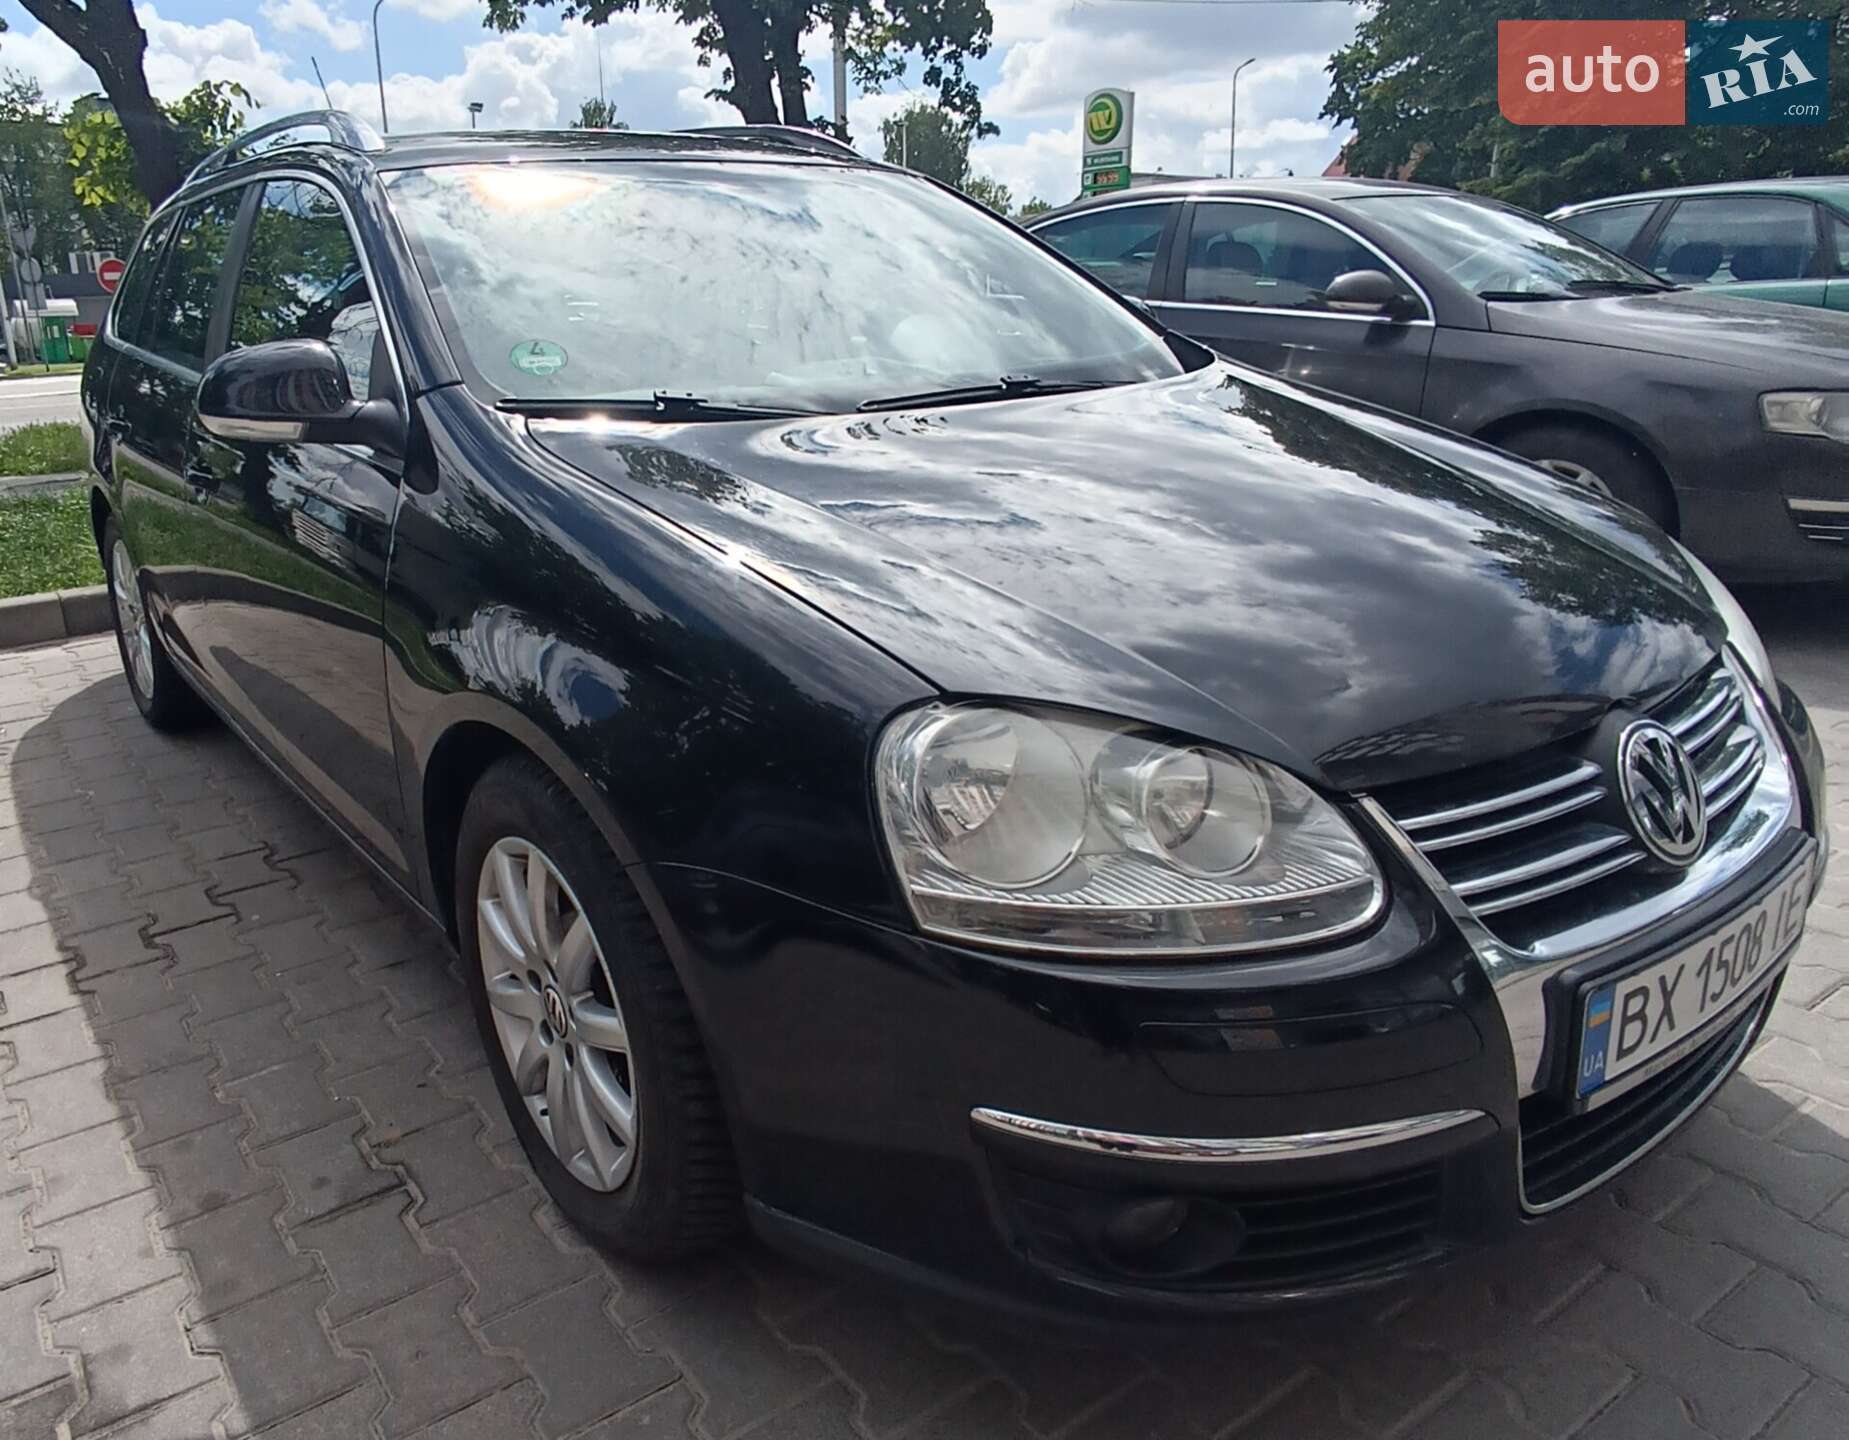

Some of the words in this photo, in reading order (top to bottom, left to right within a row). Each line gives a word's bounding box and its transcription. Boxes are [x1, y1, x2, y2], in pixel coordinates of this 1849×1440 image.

[1616, 963, 1685, 1062] BX
[1696, 909, 1768, 1013] 1508
[1772, 871, 1807, 951] IE
[1583, 1051, 1605, 1077] UA
